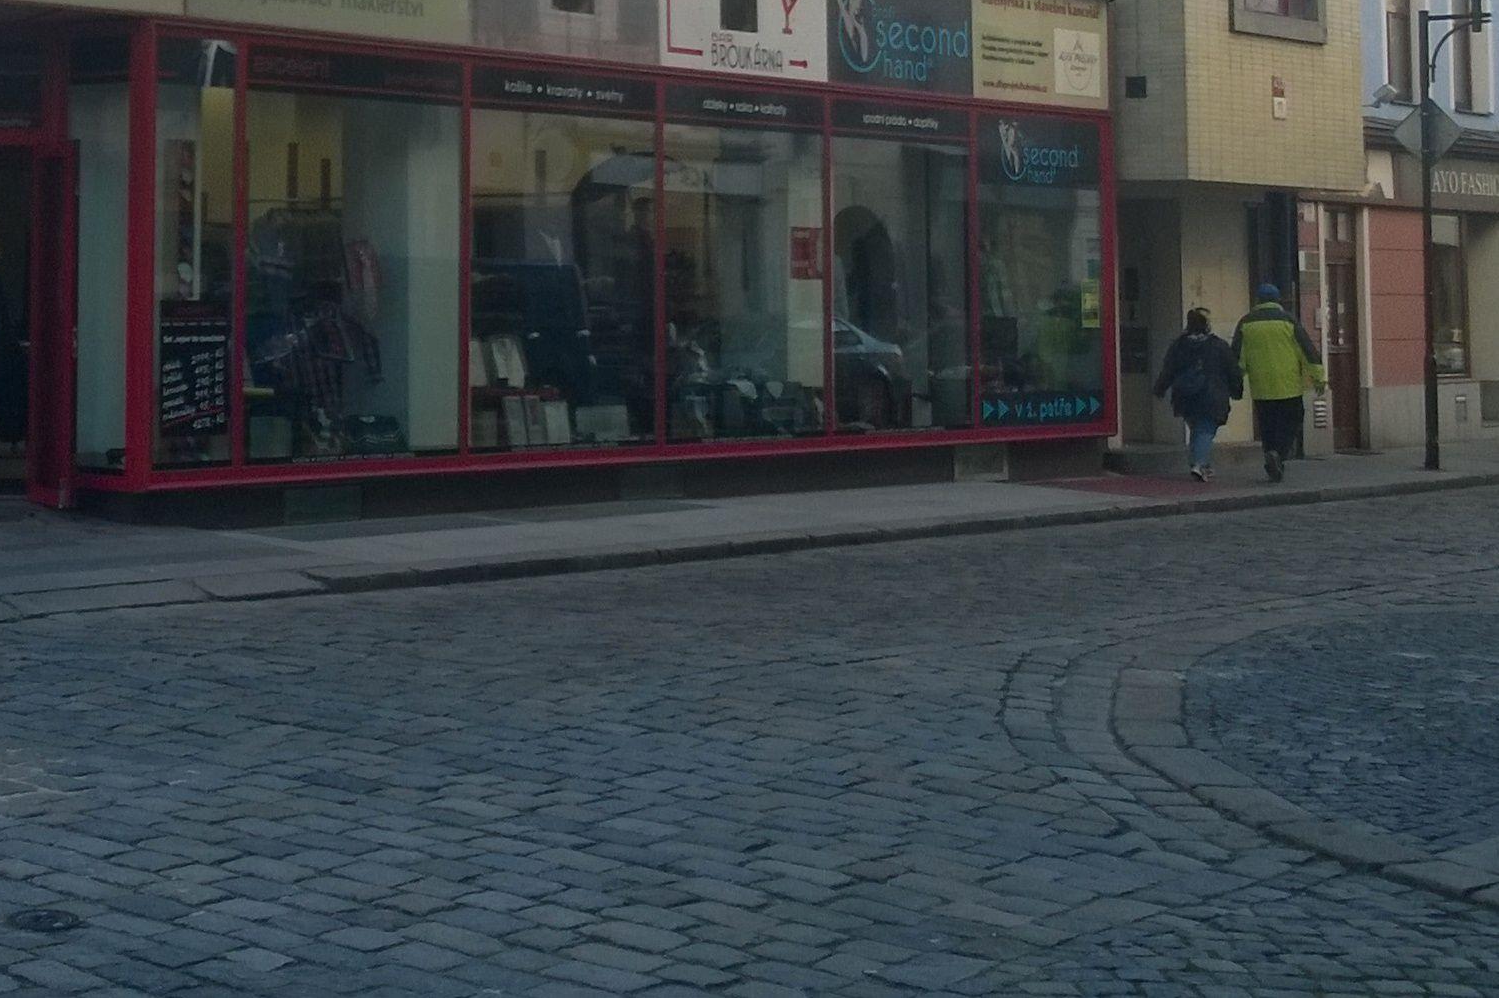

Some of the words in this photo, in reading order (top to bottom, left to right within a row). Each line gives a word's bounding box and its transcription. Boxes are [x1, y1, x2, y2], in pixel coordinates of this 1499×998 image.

[876, 19, 969, 59] second
[883, 49, 927, 82] hand
[1023, 145, 1079, 168] second
